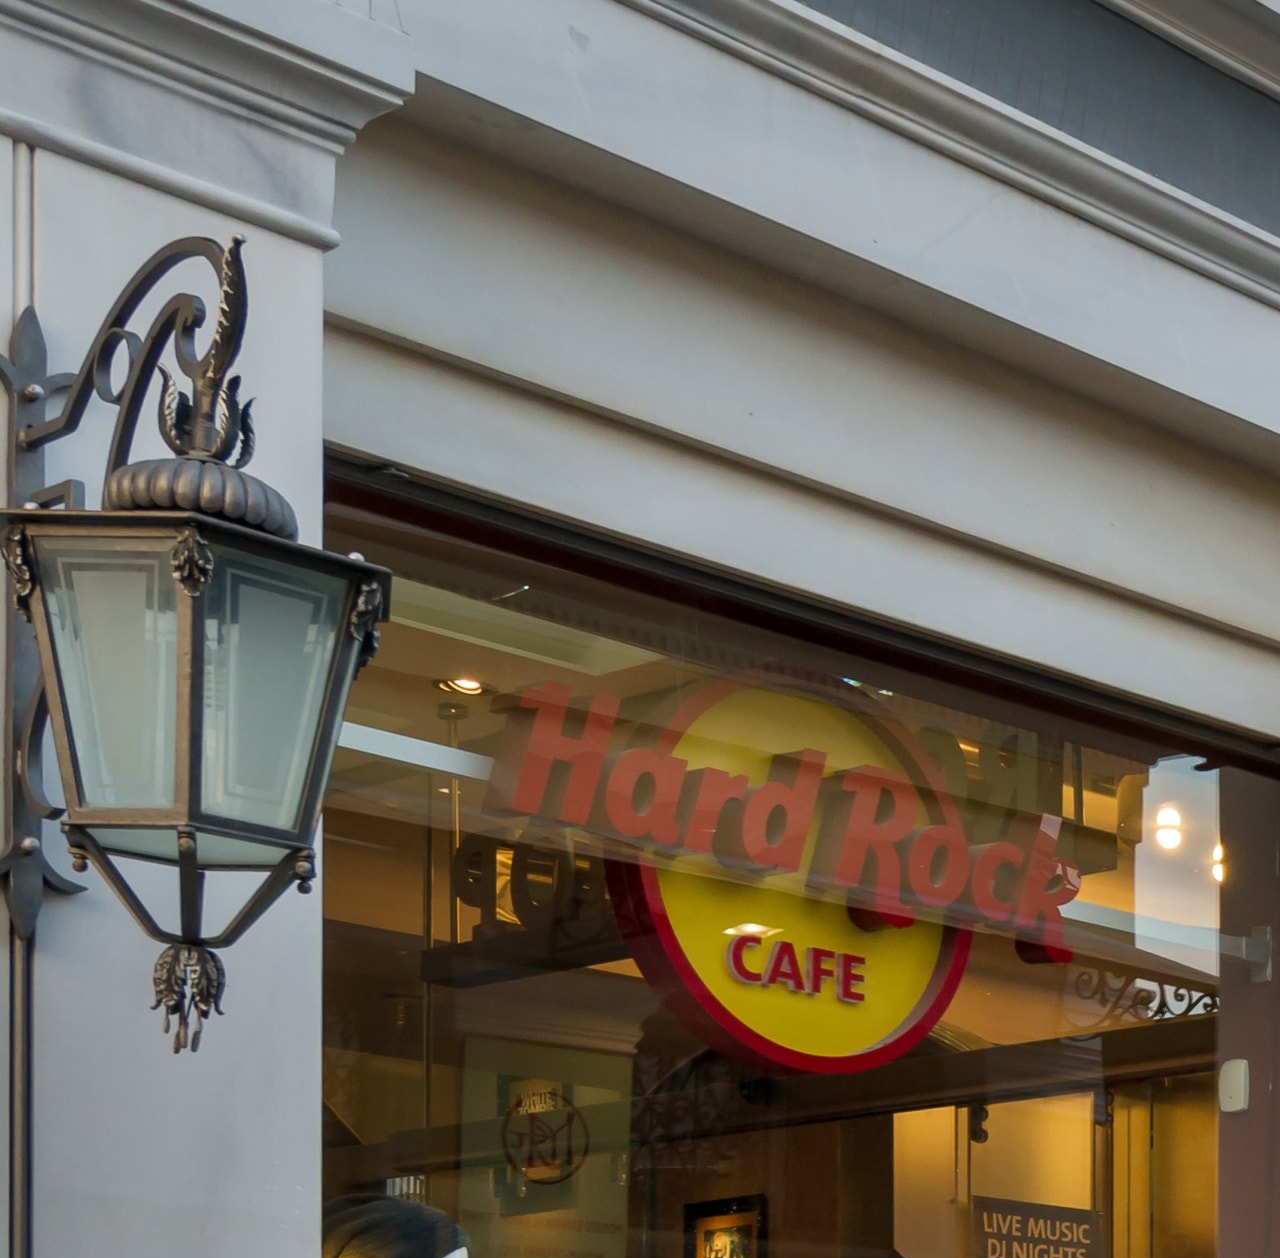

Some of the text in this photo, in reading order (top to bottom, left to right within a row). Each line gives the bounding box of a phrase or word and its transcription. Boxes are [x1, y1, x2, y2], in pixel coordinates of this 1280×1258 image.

[508, 680, 826, 874] Hard
[829, 764, 1081, 963] Rock
[727, 933, 866, 1003] CAFE
[983, 1211, 1091, 1244] LIVE MUSIC
